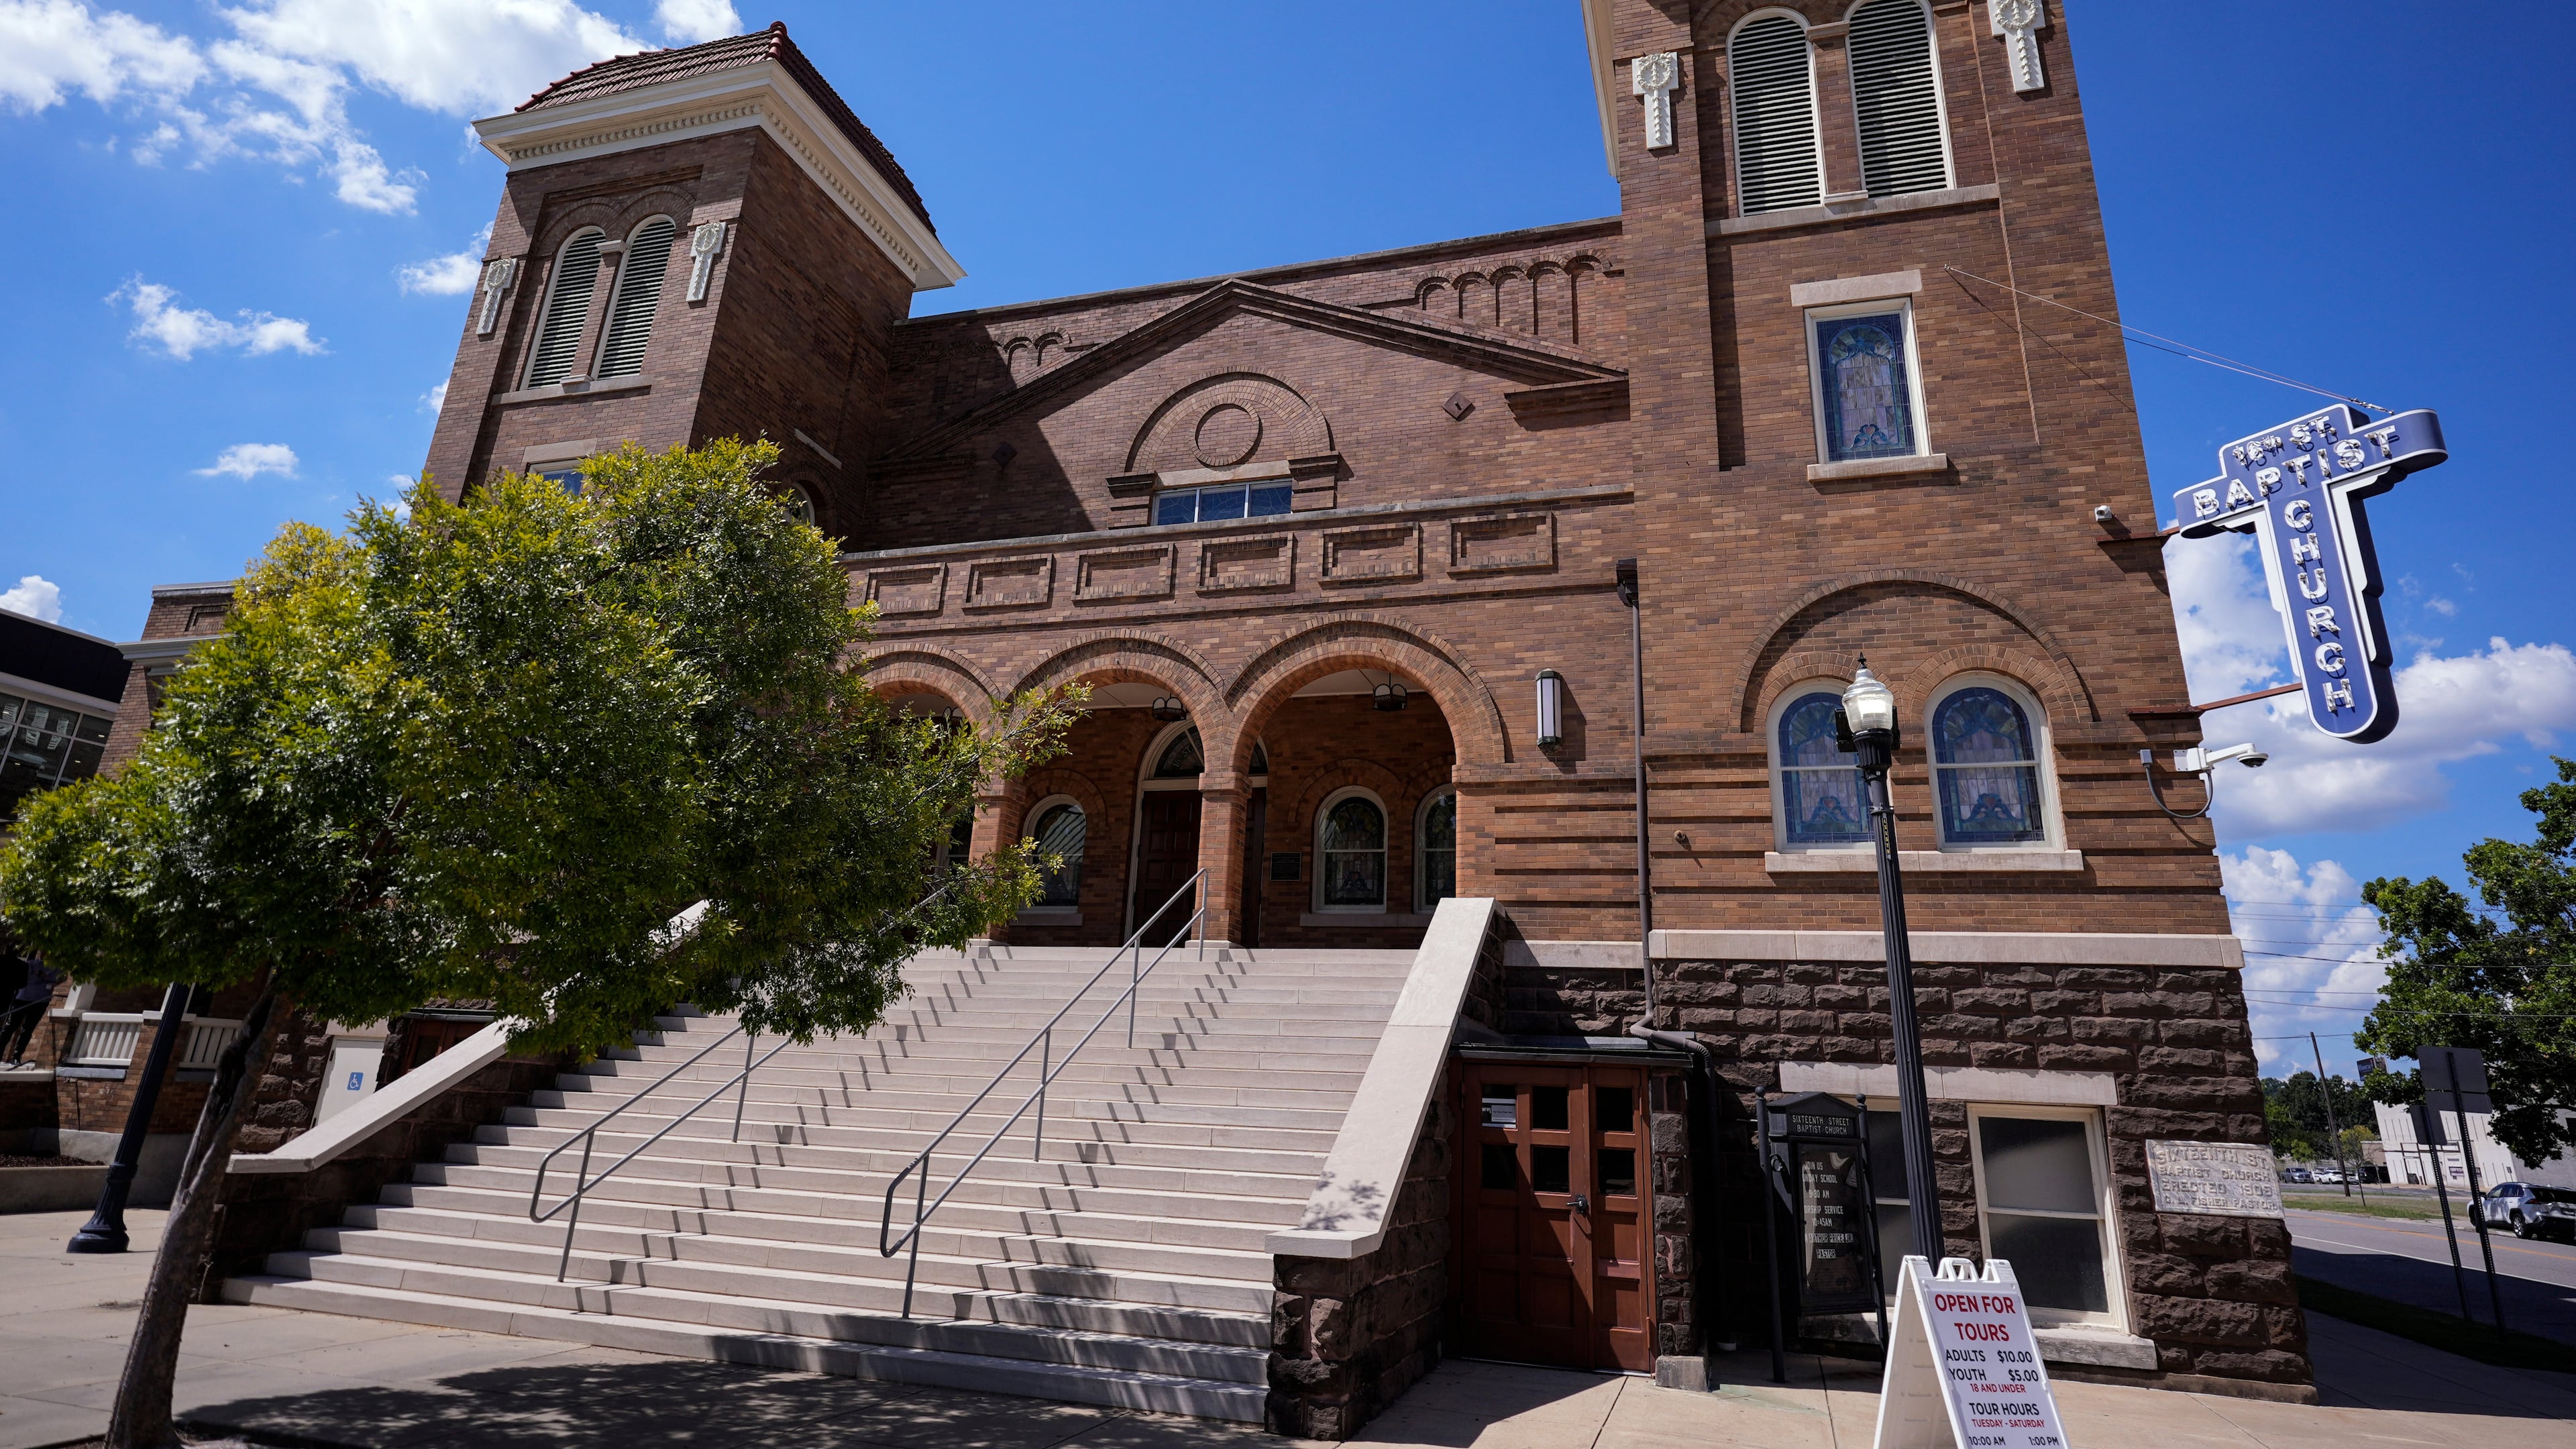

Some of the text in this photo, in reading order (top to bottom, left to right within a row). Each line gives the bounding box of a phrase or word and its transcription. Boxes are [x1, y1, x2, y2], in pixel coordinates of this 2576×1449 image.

[2290, 416, 2330, 445] ST
[2193, 425, 2396, 519] BAPTIST
[2284, 499, 2355, 712] CHURCH
[1792, 1114, 1849, 1126] SIXTEENTH STREET
[1796, 1124, 1847, 1134] BAPTIST CHURCH
[2156, 1146, 2239, 1165] SIXTEENTH
[1805, 1161, 1823, 1171] JOIN US
[1803, 1173, 1837, 1183] UNDAY SCHOOL
[2158, 1165, 2271, 1182] BAPTIST CHURCH
[2161, 1178, 2273, 1197] ERECTED 1909
[1809, 1189, 1830, 1199] 9:30 AM
[2192, 1195, 2228, 1208] FISHER
[1804, 1205, 1843, 1214] ORSHIP SERVICE
[1809, 1233, 1828, 1243] ARTHUR
[1817, 1248, 1836, 1259] PASTOR
[1935, 1294, 2017, 1314] OPEN FOR
[1954, 1323, 2010, 1341] TOURS
[1946, 1349, 2033, 1363] ADULTS $10.00
[1949, 1368, 2039, 1382] YOUTH $5.00
[1970, 1383, 2027, 1393] 18 AND UNDER
[1969, 1403, 2039, 1415] TOUR HOURS
[1972, 1419, 2003, 1428] TUESDAY
[2009, 1419, 2045, 1428] SATURDAY
[1968, 1436, 2059, 1446] 10:00 AM 1:00 PM
